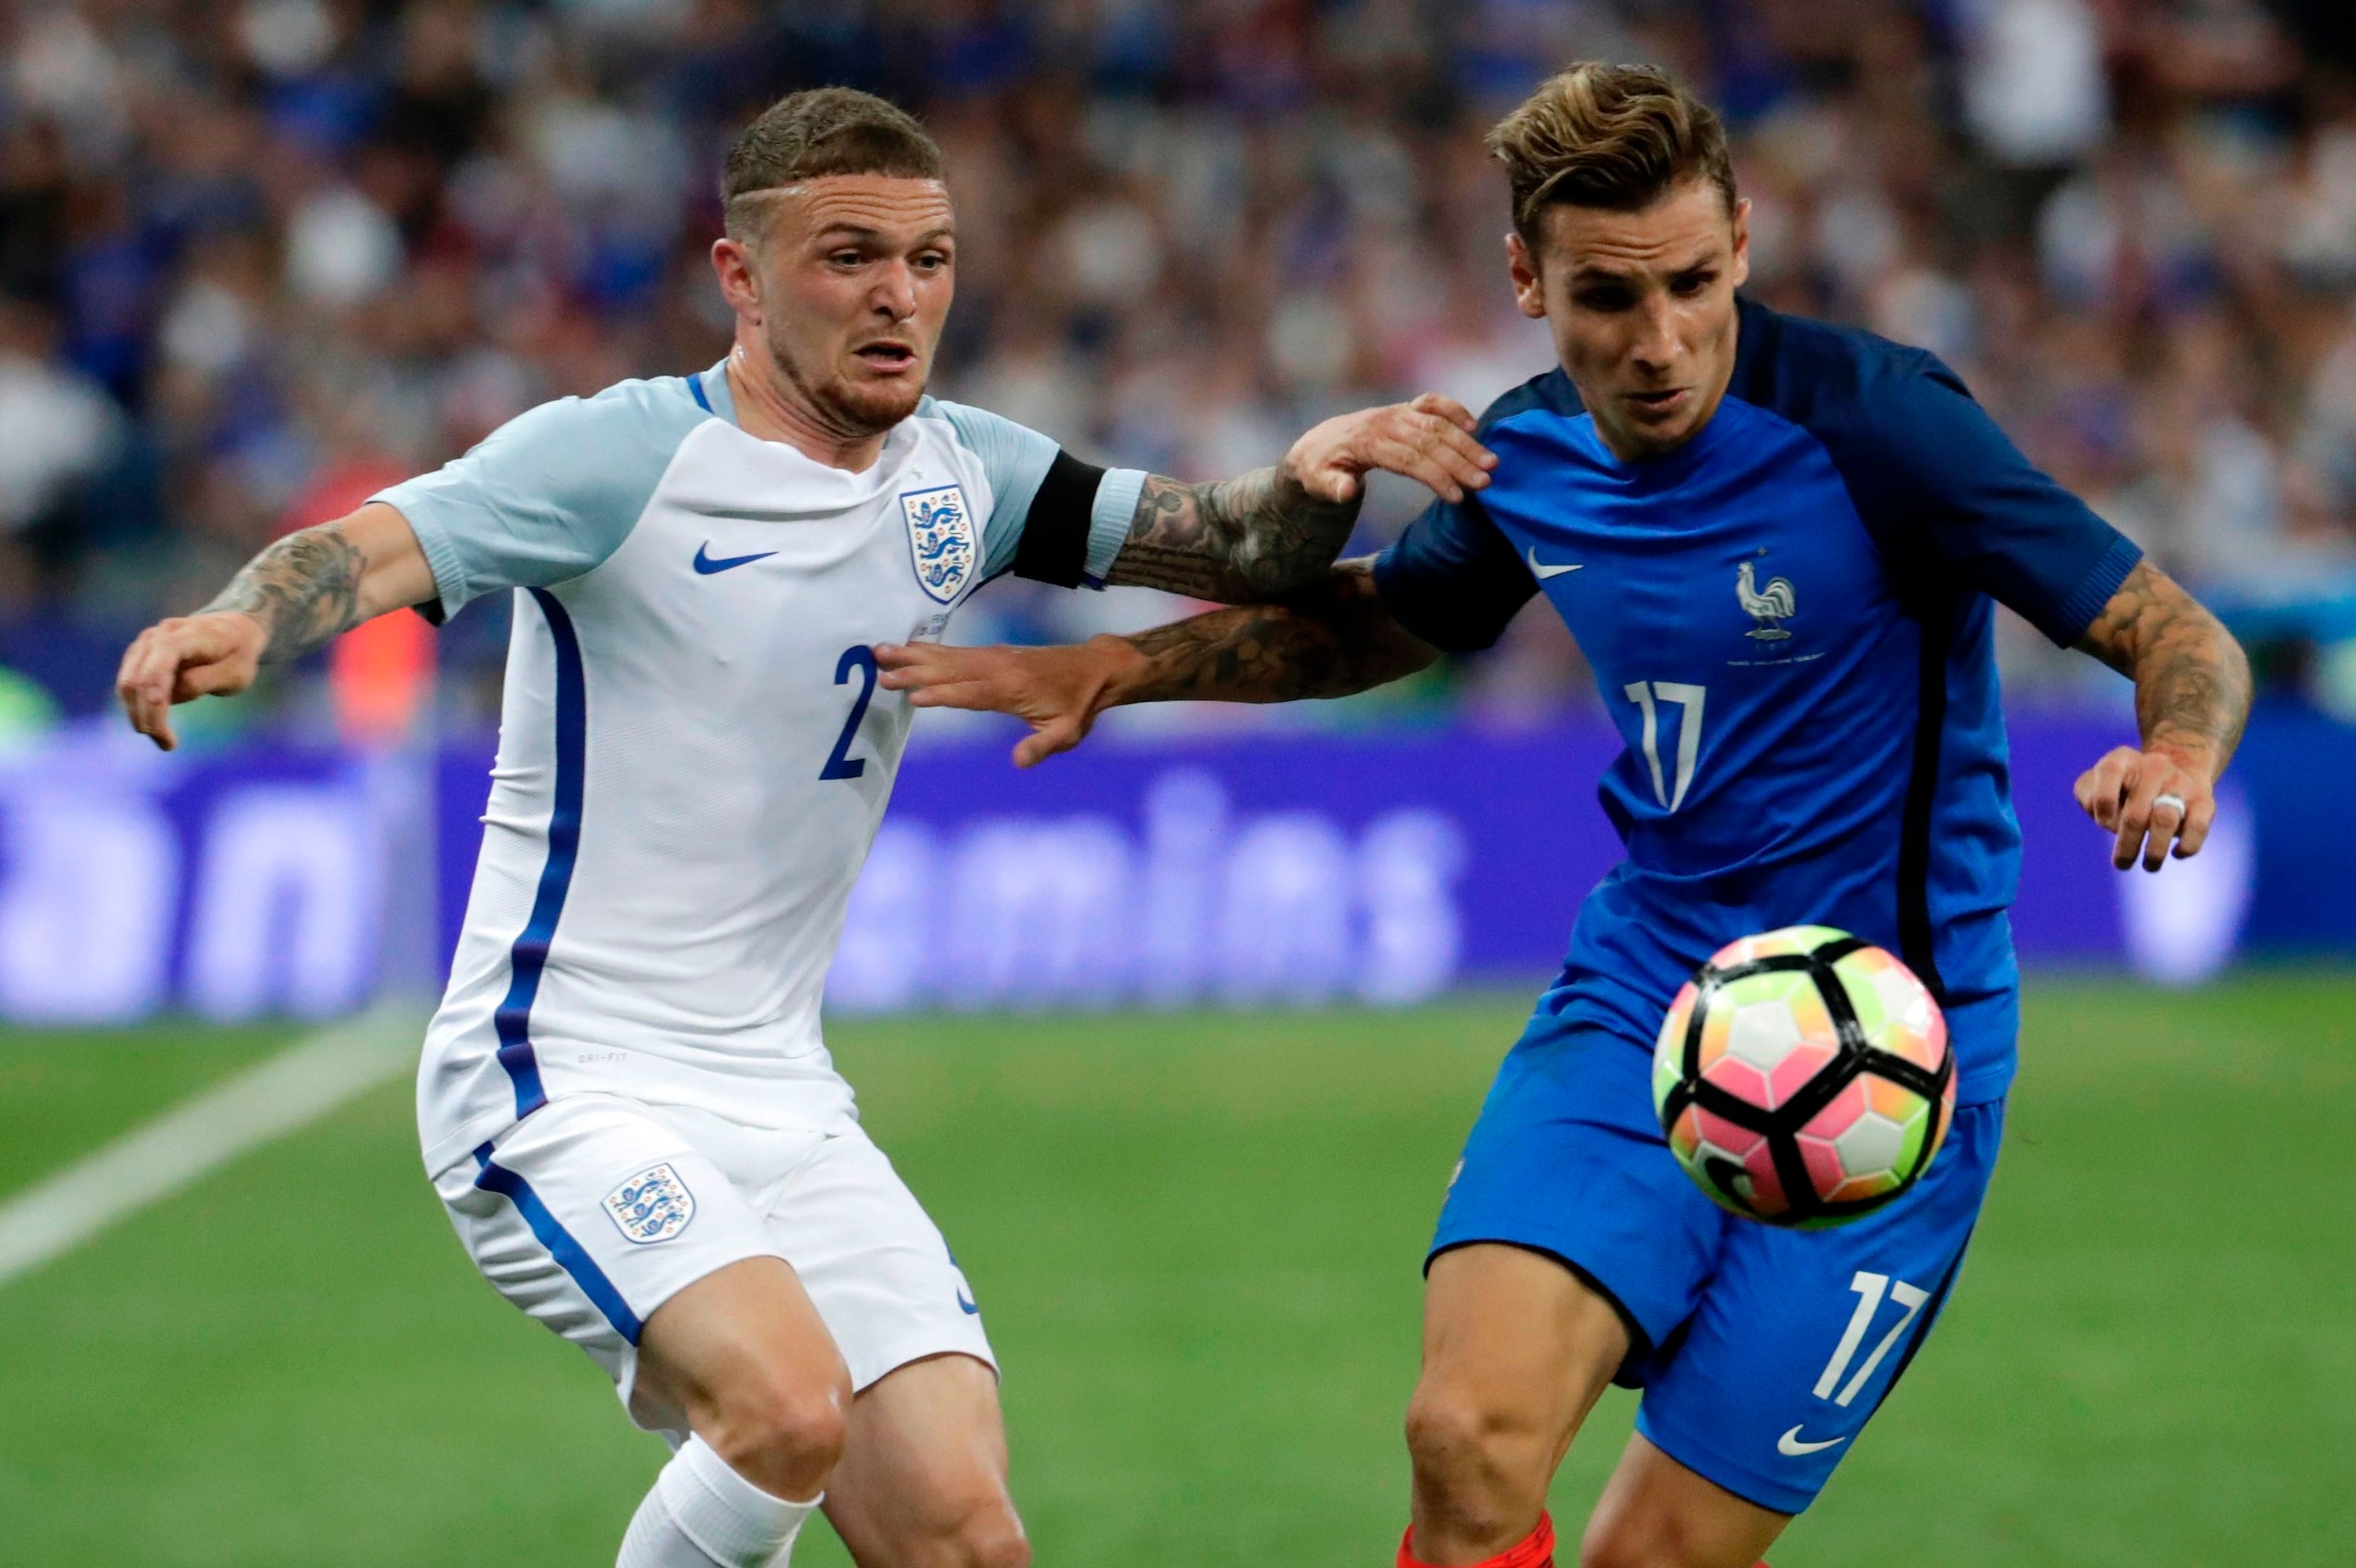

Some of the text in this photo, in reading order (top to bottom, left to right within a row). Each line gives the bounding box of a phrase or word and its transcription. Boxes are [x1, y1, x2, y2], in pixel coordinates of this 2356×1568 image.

[818, 644, 878, 781] 2
[1624, 681, 1707, 813] 17
[578, 1052, 627, 1064] DRI-FIT
[1812, 1271, 1931, 1408] 17
